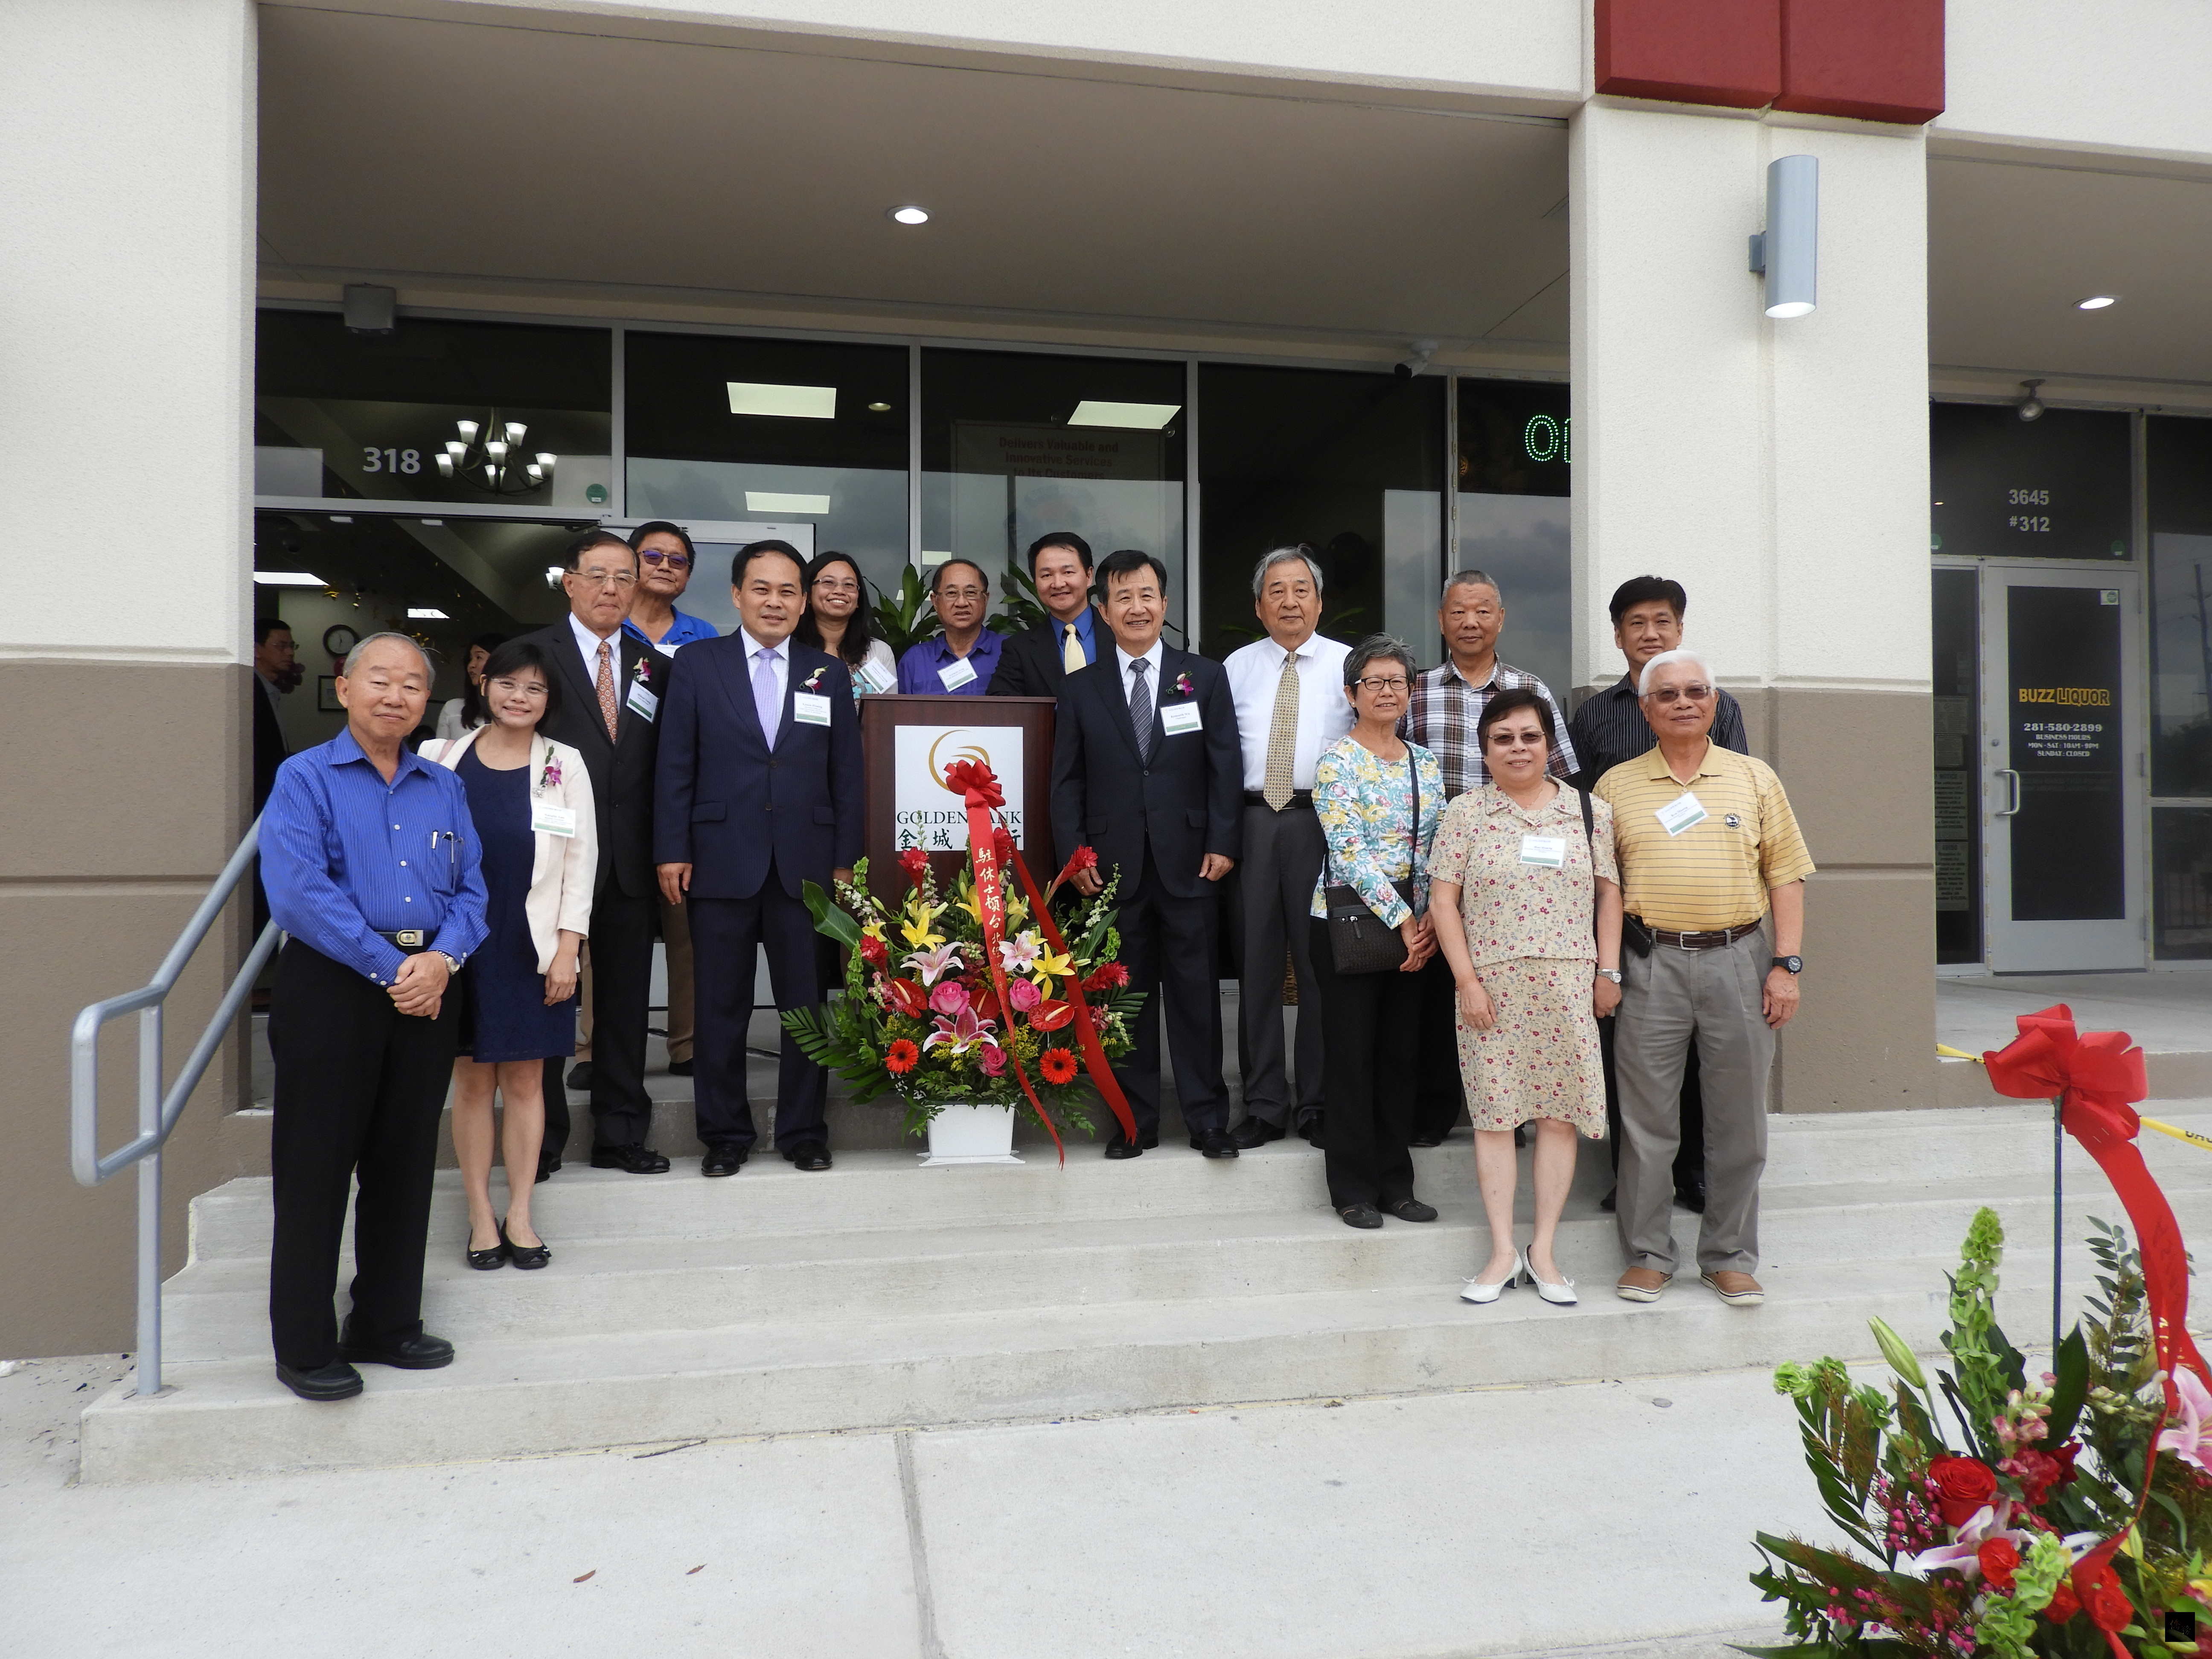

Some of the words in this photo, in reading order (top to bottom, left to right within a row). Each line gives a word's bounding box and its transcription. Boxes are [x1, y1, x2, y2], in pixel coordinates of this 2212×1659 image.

[999, 437, 1044, 449] Delivers
[1046, 438, 1095, 451] Valuable
[1098, 442, 1118, 453] and
[363, 447, 421, 474] 318
[1006, 452, 1062, 465] Innovative
[1066, 454, 1112, 467] Services
[2009, 489, 2049, 505] 3645
[2009, 516, 2049, 532] #312
[2019, 688, 2055, 703] BUZZ
[2057, 687, 2110, 707] LIQUOR
[2023, 723, 2103, 732] 281-580-2899
[897, 811, 968, 824] GOLDEN
[989, 812, 1022, 824] ANK
